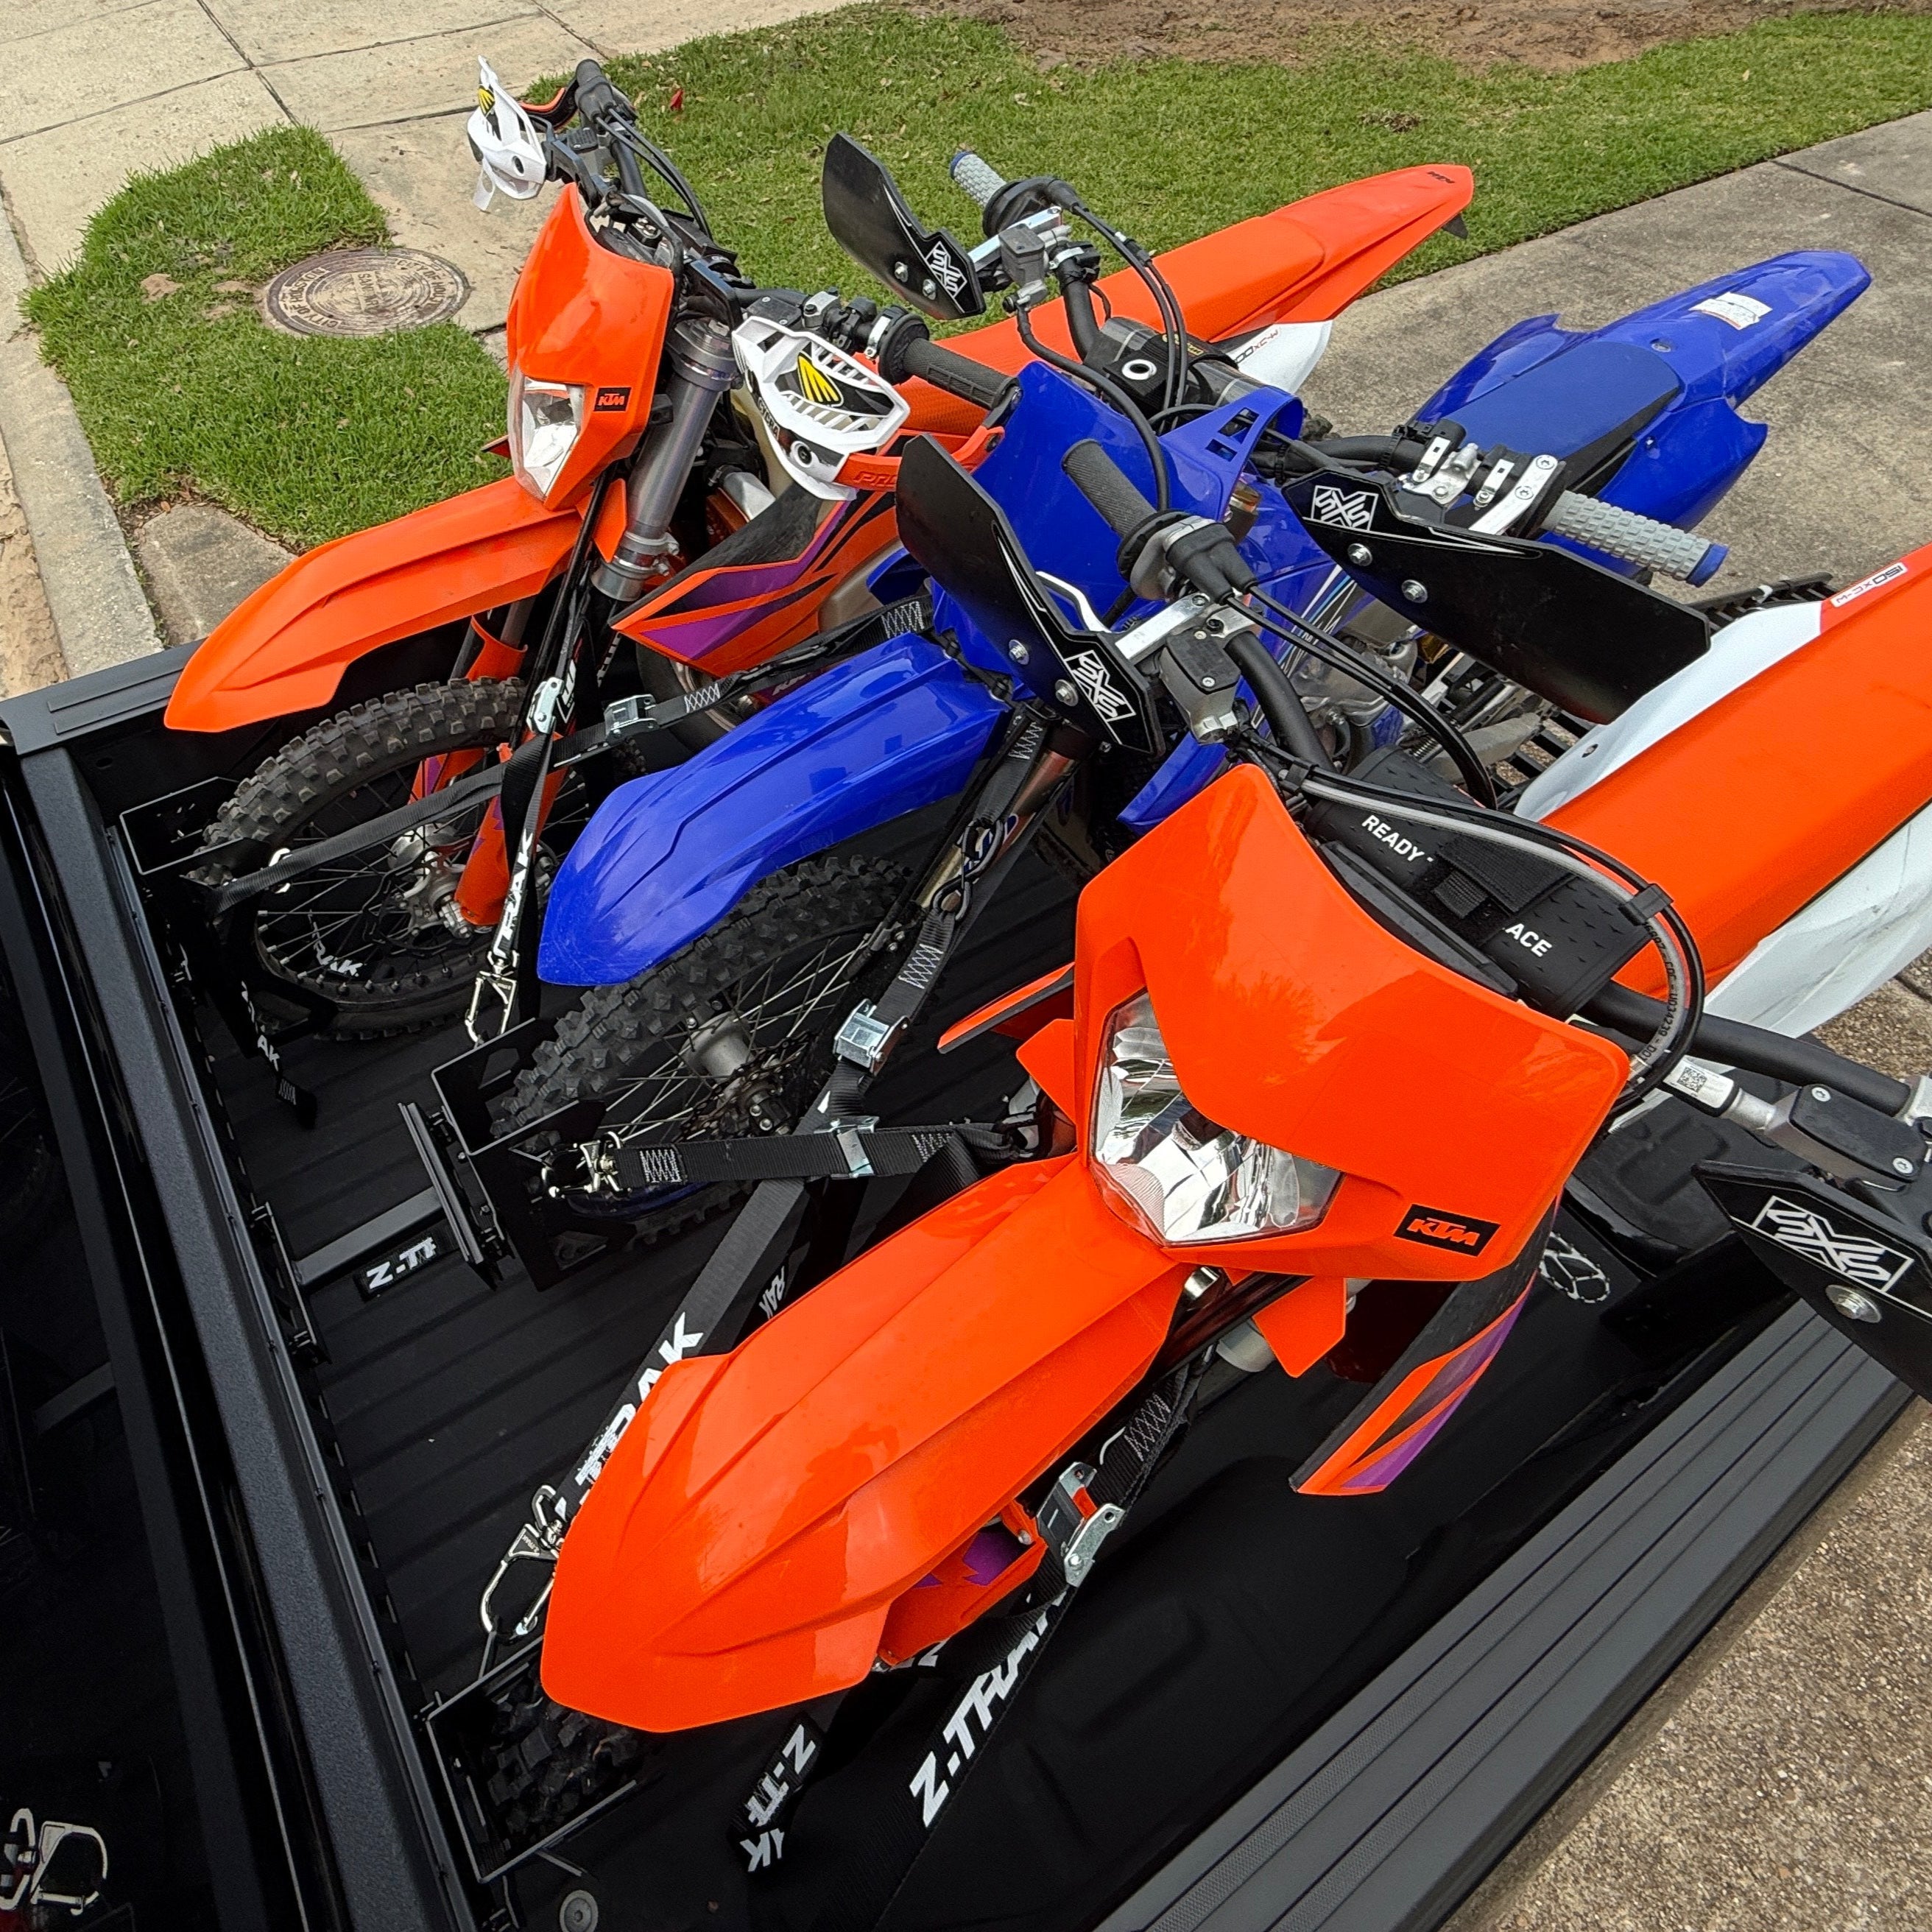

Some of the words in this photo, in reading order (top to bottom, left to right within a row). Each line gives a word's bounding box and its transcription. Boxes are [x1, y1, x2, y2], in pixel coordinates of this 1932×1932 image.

[396, 258, 429, 275] CITY
[427, 269, 442, 285] OF
[295, 300, 311, 314] OF
[304, 313, 338, 329] CITY
[597, 393, 625, 406] KTM
[1361, 814, 1425, 861] READY
[1504, 923, 1553, 957] ACE
[1406, 1217, 1481, 1246] KTM
